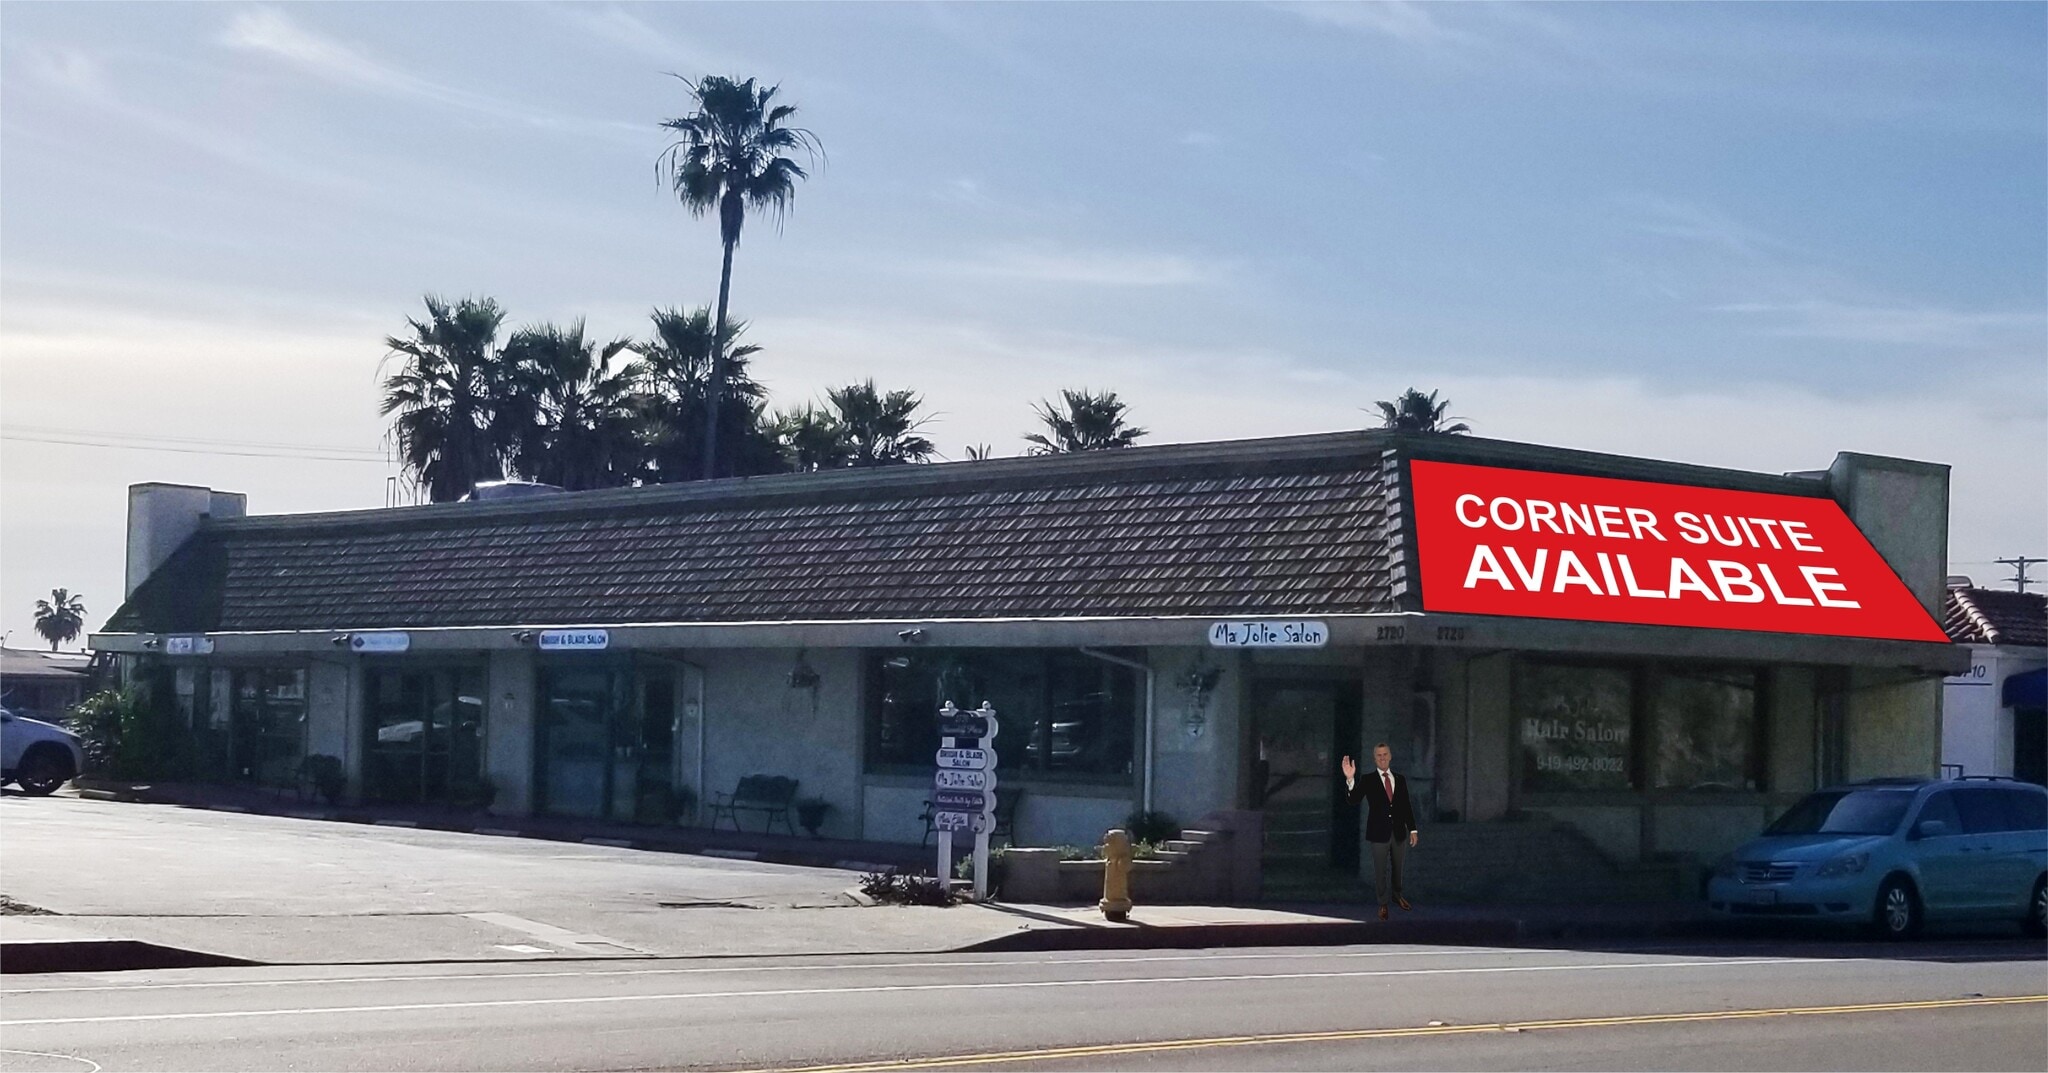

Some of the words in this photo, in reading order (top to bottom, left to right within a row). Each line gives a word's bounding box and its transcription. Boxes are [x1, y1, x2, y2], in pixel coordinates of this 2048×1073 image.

[587, 634, 606, 645] SALON
[1215, 623, 1236, 645] Ma
[1240, 623, 1277, 645] Jolie
[1283, 622, 1321, 644] Salon
[1376, 625, 1405, 641] 2720
[1527, 718, 1570, 740] Hair
[1574, 720, 1625, 744] Salon
